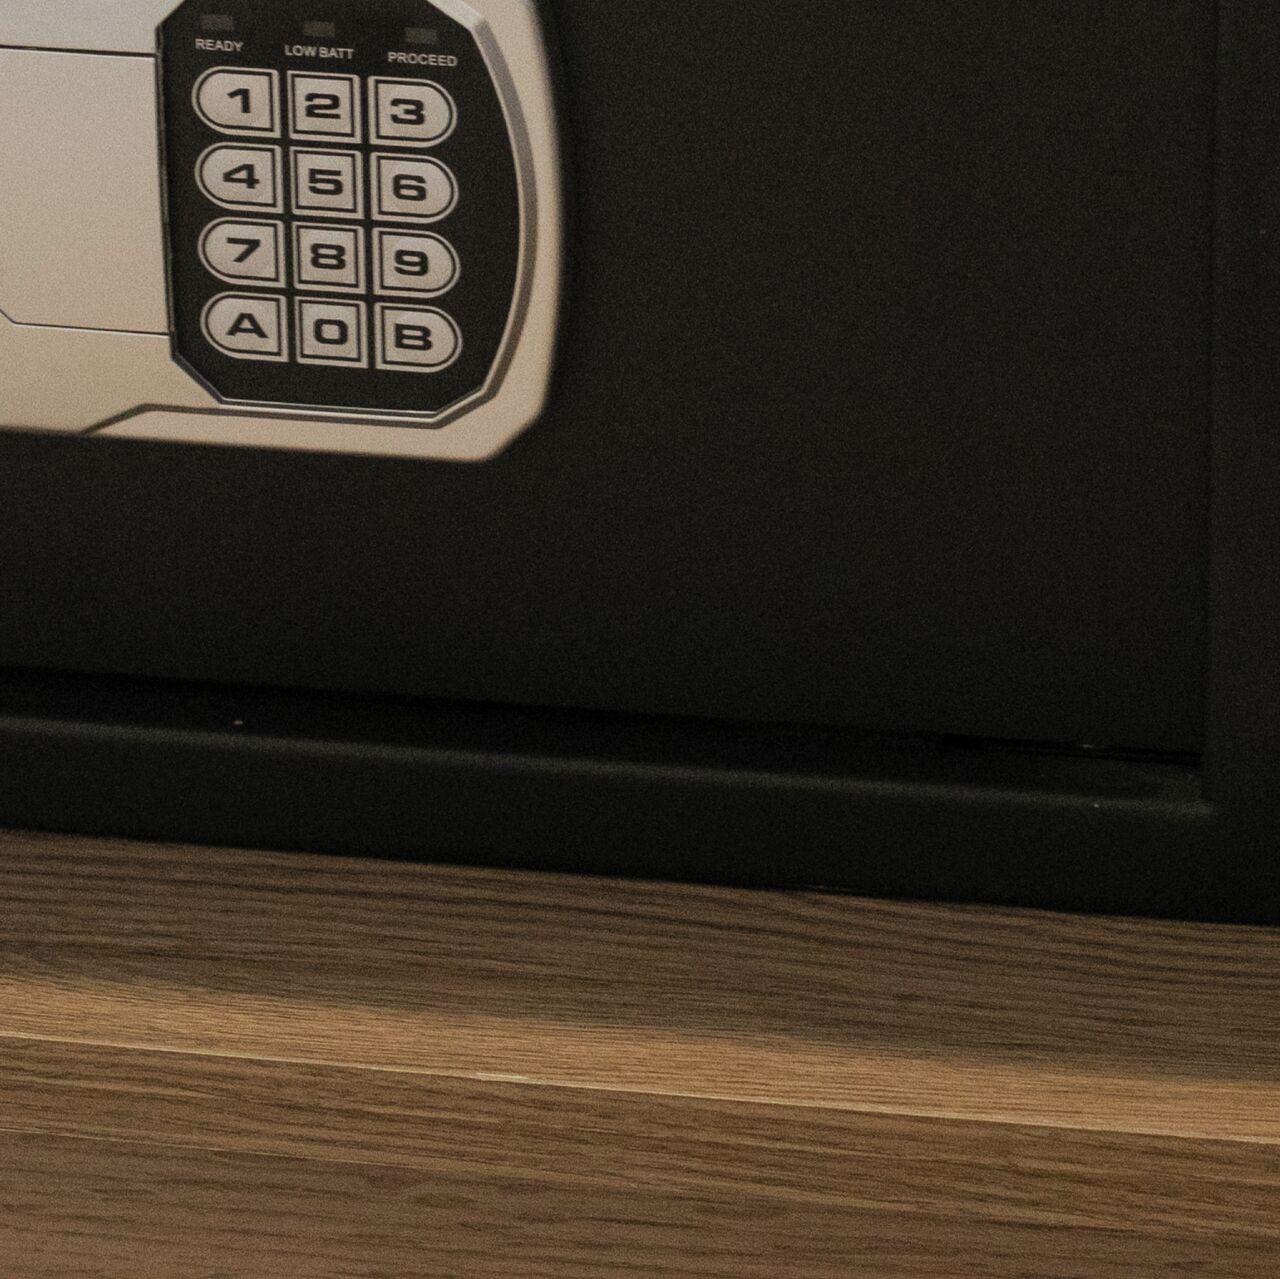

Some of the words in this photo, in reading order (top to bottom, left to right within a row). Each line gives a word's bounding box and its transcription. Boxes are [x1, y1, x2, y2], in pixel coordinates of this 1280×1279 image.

[195, 38, 244, 52] READY
[284, 44, 317, 57] LOW
[318, 46, 355, 59] BATT
[387, 51, 458, 67] PROCEED
[227, 88, 251, 114] 1
[304, 93, 342, 120] 2
[390, 98, 426, 125] 3
[222, 163, 260, 190] 4
[308, 168, 345, 196] 5
[392, 174, 428, 202] 6
[226, 237, 262, 263] 7
[310, 243, 347, 270] 8
[394, 249, 430, 277] 9
[225, 312, 269, 339] A
[313, 318, 350, 346] 0
[393, 323, 433, 351] B
